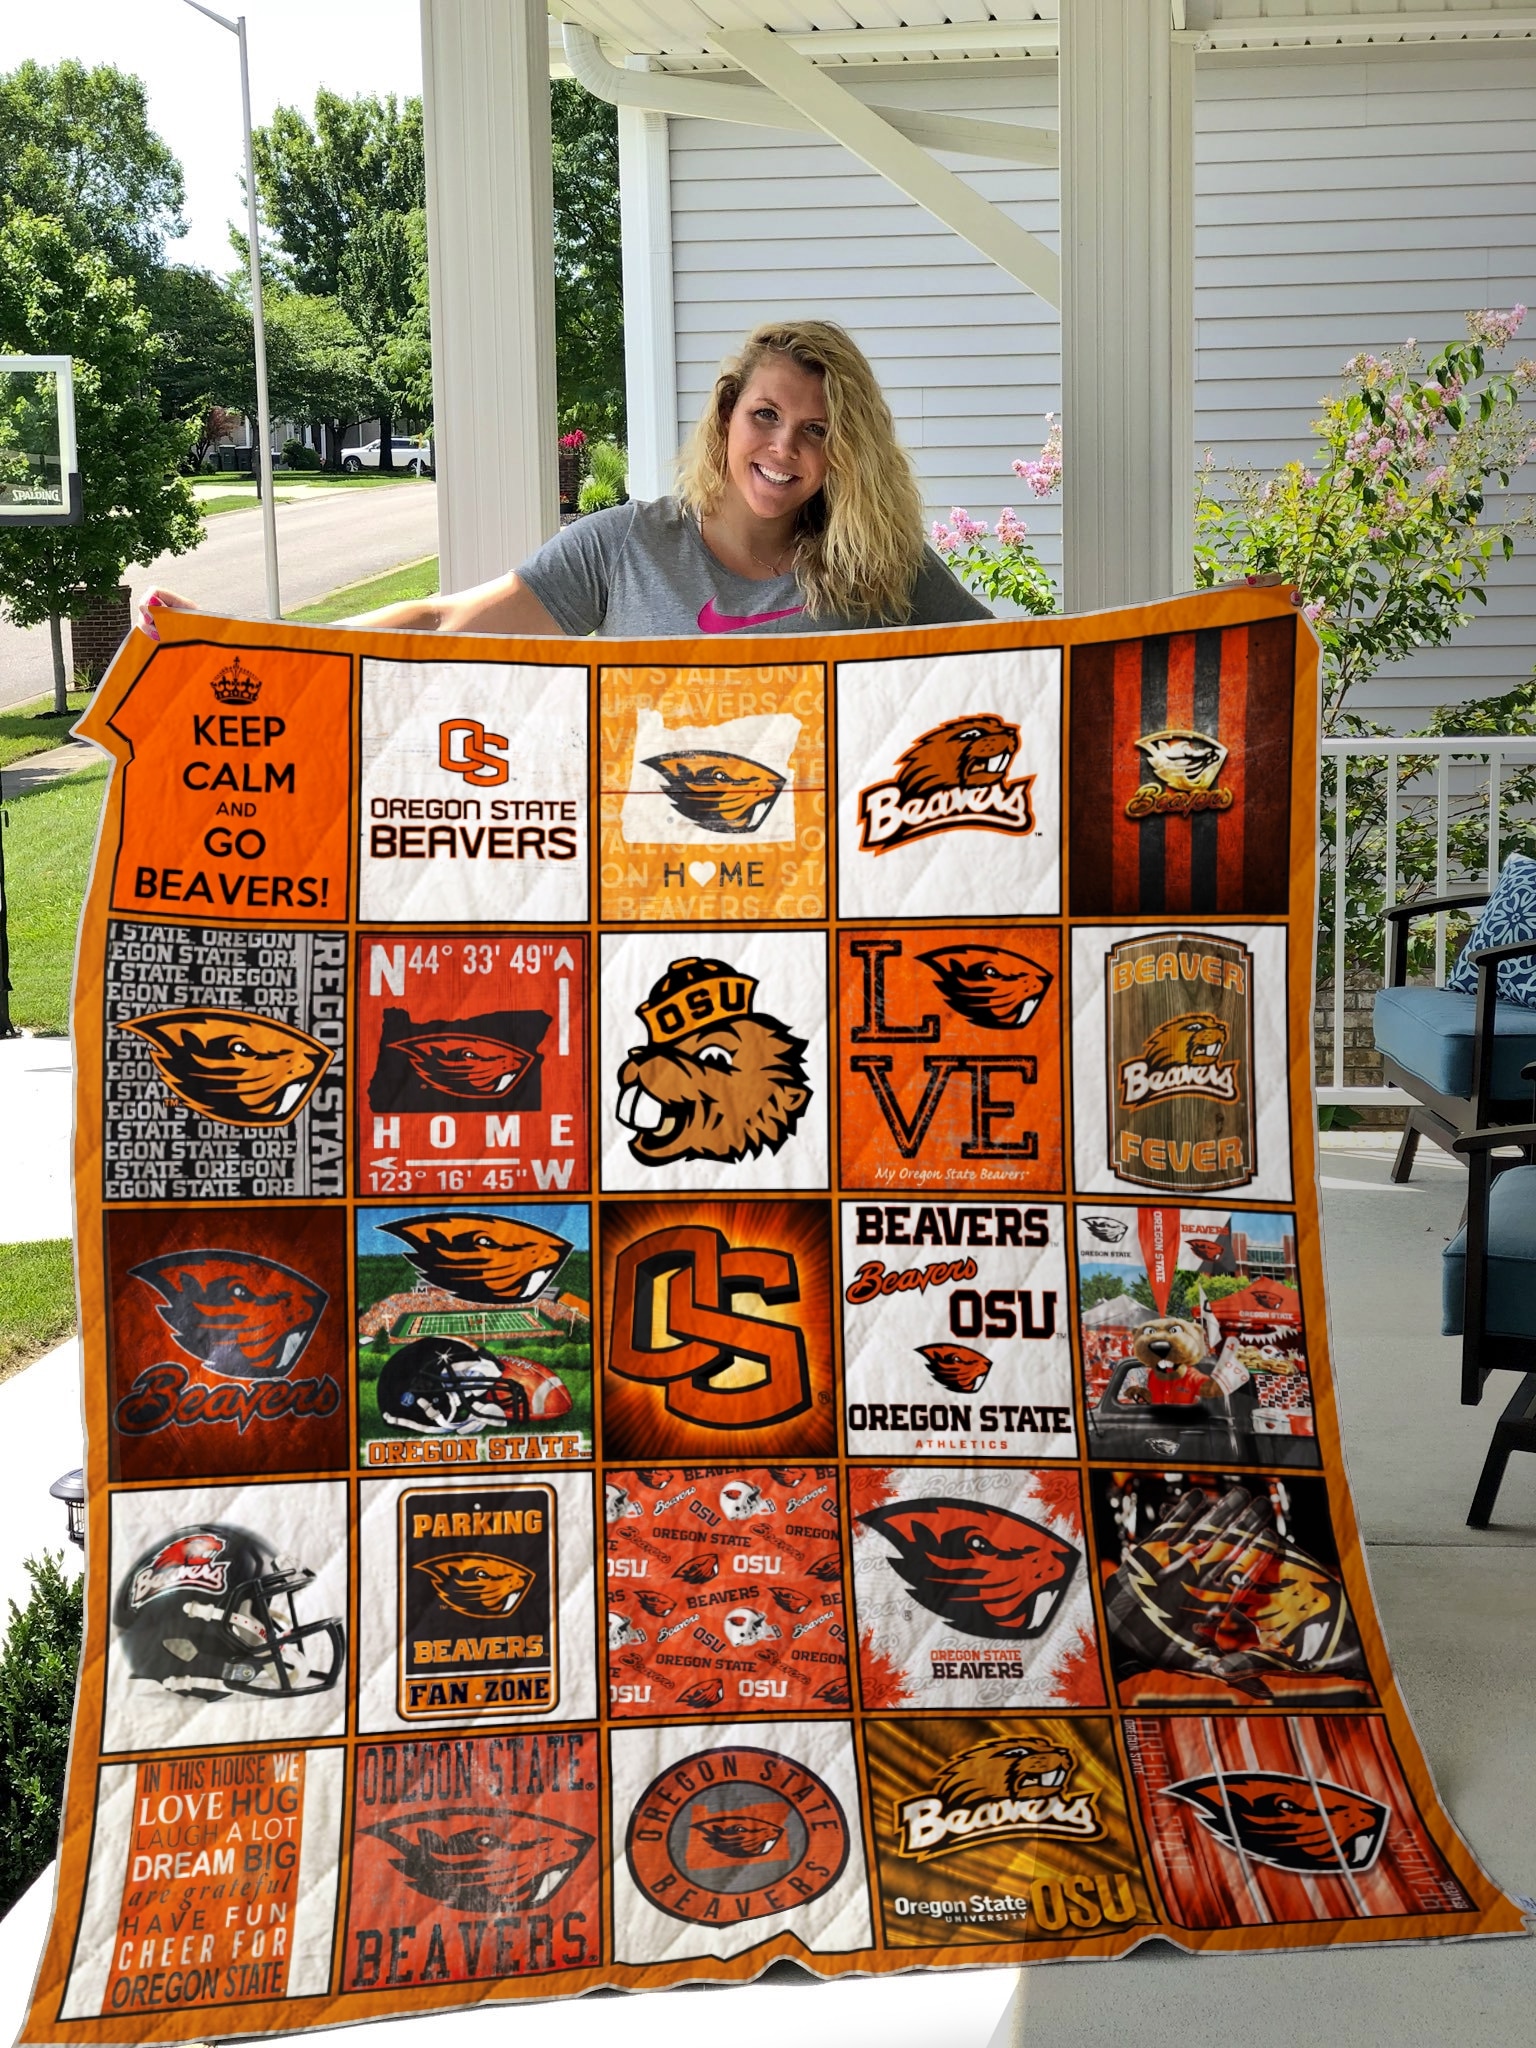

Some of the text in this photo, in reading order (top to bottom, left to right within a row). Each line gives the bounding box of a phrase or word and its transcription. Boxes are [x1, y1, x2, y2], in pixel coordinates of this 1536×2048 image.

[12, 489, 60, 501] SPALDING
[193, 715, 286, 747] KEEP
[182, 762, 295, 794] CALM
[216, 802, 257, 818] AND
[371, 798, 576, 821] OREGON STATE
[865, 784, 1028, 844] Beavers
[1124, 783, 1232, 819] Beavers
[204, 827, 266, 860] GO
[370, 825, 577, 860] BEAVERS
[134, 866, 329, 908] BEAVERS!
[202, 930, 295, 949] OREGON
[179, 947, 247, 966] STATE
[369, 944, 406, 997] N
[408, 945, 453, 974] 44°
[120, 963, 294, 987] STATE OREGON
[1113, 952, 1244, 994] BEAVER
[174, 986, 243, 1004] STATE
[656, 981, 745, 1034] OSU
[1125, 1062, 1235, 1103] Beavers
[118, 1121, 289, 1139] STATE OREGON
[373, 1114, 574, 1149] HOME
[171, 1141, 240, 1159] STATE
[1120, 1130, 1244, 1173] FEVER
[115, 1160, 287, 1179] STATE OREGON
[369, 1170, 427, 1192] 123°
[531, 1158, 575, 1190] W
[875, 1168, 1026, 1186] My Oregon State Beavers
[172, 1179, 241, 1197] STATE
[856, 1206, 1049, 1247] BEAVERS
[1181, 1224, 1229, 1235] BEAVERS
[1153, 1211, 1166, 1283] OREGON STATE
[845, 1256, 978, 1305] Beavers
[949, 1289, 1058, 1340] OSU
[114, 1361, 341, 1437] Beavers
[849, 1404, 1071, 1433] OREGON STATE
[368, 1434, 580, 1465] OREGON STATE
[915, 1439, 1008, 1450] ATHLETICS
[653, 1487, 696, 1516] Beavers
[689, 1499, 721, 1527] OSU
[785, 1485, 828, 1513] Beavers
[413, 1509, 543, 1539] PARKING
[652, 1527, 752, 1547] OREGON STATE
[785, 1525, 839, 1541] OREGON
[733, 1555, 782, 1575] OSU
[686, 1585, 760, 1609] BEAVERS
[657, 1614, 699, 1643] Beavers
[692, 1627, 726, 1653] OSU
[792, 1611, 834, 1638] Beavers
[413, 1635, 545, 1664] BEAVERS
[656, 1654, 757, 1673] OREGON STATE
[930, 1650, 1021, 1661] OREGON STATE
[932, 1662, 1024, 1679] BEAVERS
[409, 1677, 549, 1709] FAN ZONE
[738, 1679, 788, 1698] OSU
[1124, 1719, 1144, 1774] OREGON STATE
[144, 1753, 299, 1793] IN THIS HOUSE WE
[363, 1734, 585, 1806] OREGON STATE
[139, 1785, 298, 1826] LOVE HUG
[636, 1755, 839, 1842] OREGON STATE
[136, 1817, 297, 1850] LAUGH A LOT
[903, 1797, 1097, 1850] Beavers
[132, 1841, 296, 1882] DREAM BIG
[128, 1871, 292, 1911] are grateful
[651, 1861, 830, 1919] BEAVERS
[1031, 1873, 1137, 1931] OSU
[122, 1903, 287, 1937] HAVE FUN
[895, 1895, 1027, 1918] Oregon State
[945, 1912, 1027, 1924] UNIVERSITY
[118, 1927, 287, 1971] CHEER FOR
[352, 1911, 589, 1987] BEAVERS
[111, 1961, 284, 2008] OREGON STATE
